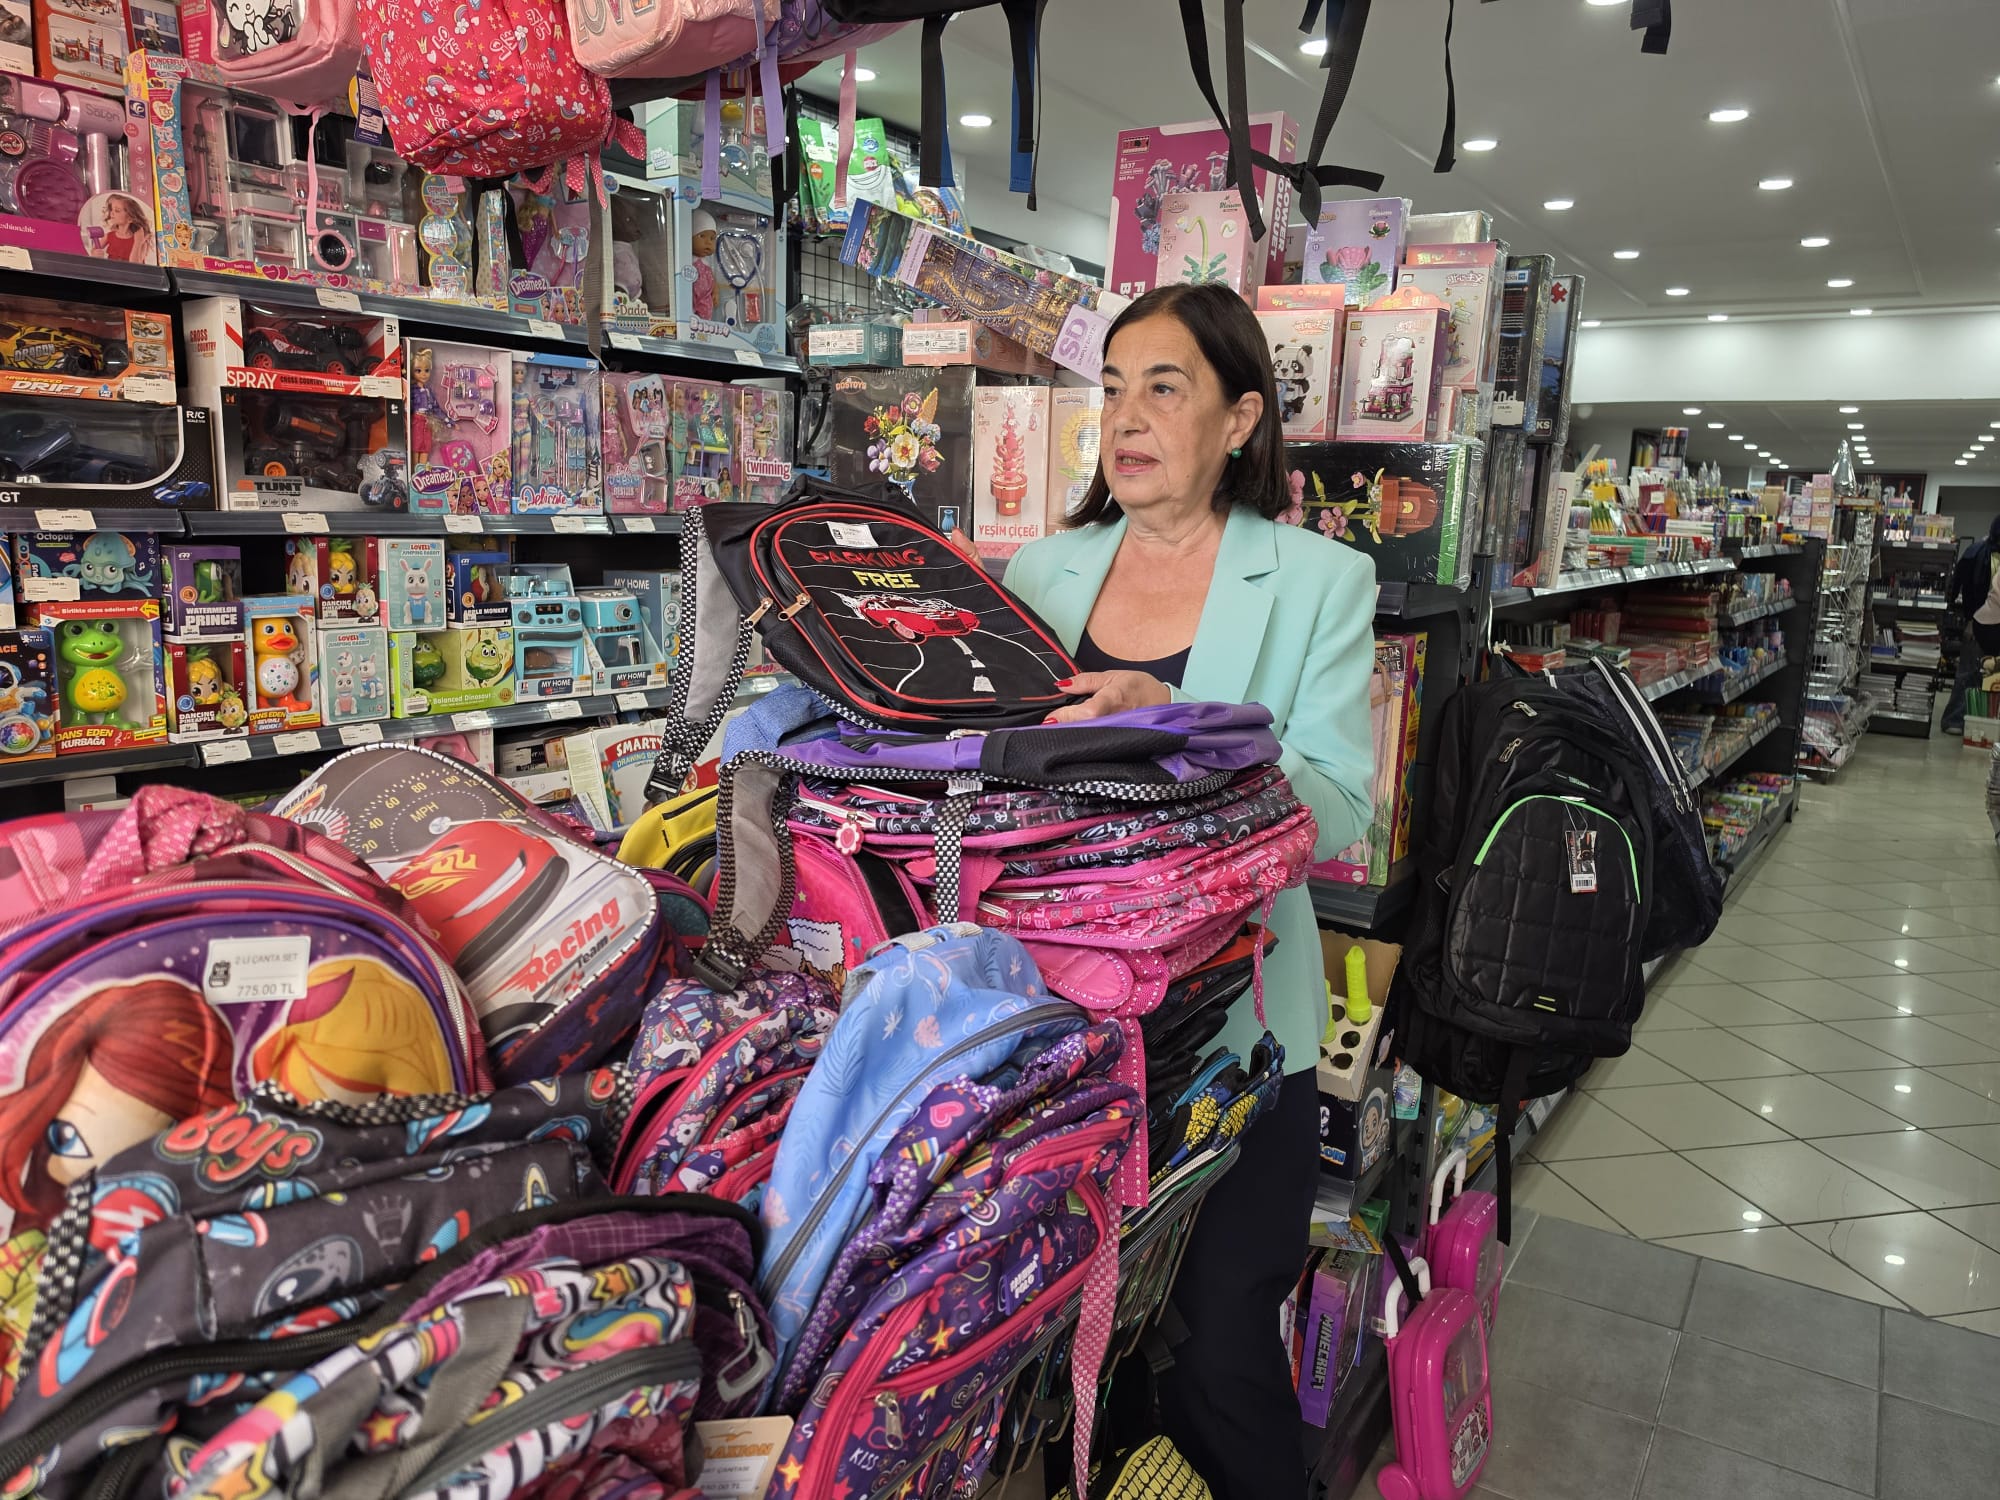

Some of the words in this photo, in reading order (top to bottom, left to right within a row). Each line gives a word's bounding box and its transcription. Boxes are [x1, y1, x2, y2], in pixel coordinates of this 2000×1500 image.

[190, 329, 208, 342] CROSS
[1058, 318, 1088, 361] SD
[14, 343, 55, 362] DRAGON
[227, 370, 277, 389] SPRAY
[11, 381, 89, 394] DRIFT
[186, 410, 205, 419] R/C
[746, 459, 790, 480] twinning
[36, 533, 74, 541] Octopus
[979, 524, 1007, 537] YEŞİM
[1008, 524, 1038, 538] ÇİÇEĞİ
[809, 548, 926, 568] PARKING
[614, 578, 626, 587] MY
[627, 580, 650, 590] HOME
[852, 570, 920, 588] FREE
[186, 607, 237, 615] WATERMELON
[185, 613, 238, 626] PRINCE
[541, 679, 552, 688] MY
[552, 678, 571, 687] HOME
[617, 673, 628, 681] MY
[629, 671, 646, 680] HOME
[179, 711, 215, 720] DANCING
[56, 729, 83, 741] DANS
[86, 728, 113, 738] EDEN
[61, 737, 106, 749] KURBAĞA
[616, 737, 662, 757] SMARTY
[616, 752, 647, 768] DRAWING
[411, 781, 428, 795] 80
[440, 775, 460, 787] 100
[464, 779, 480, 788] 12
[384, 796, 400, 811] 60
[410, 801, 440, 824] MPH
[368, 817, 384, 831] 40
[362, 839, 378, 855] 20
[503, 897, 620, 992] Racing
[575, 936, 609, 968] Team
[281, 983, 294, 994] TL
[1312, 1313, 1334, 1392] MINECRAFT
[849, 1447, 880, 1471] KISS
